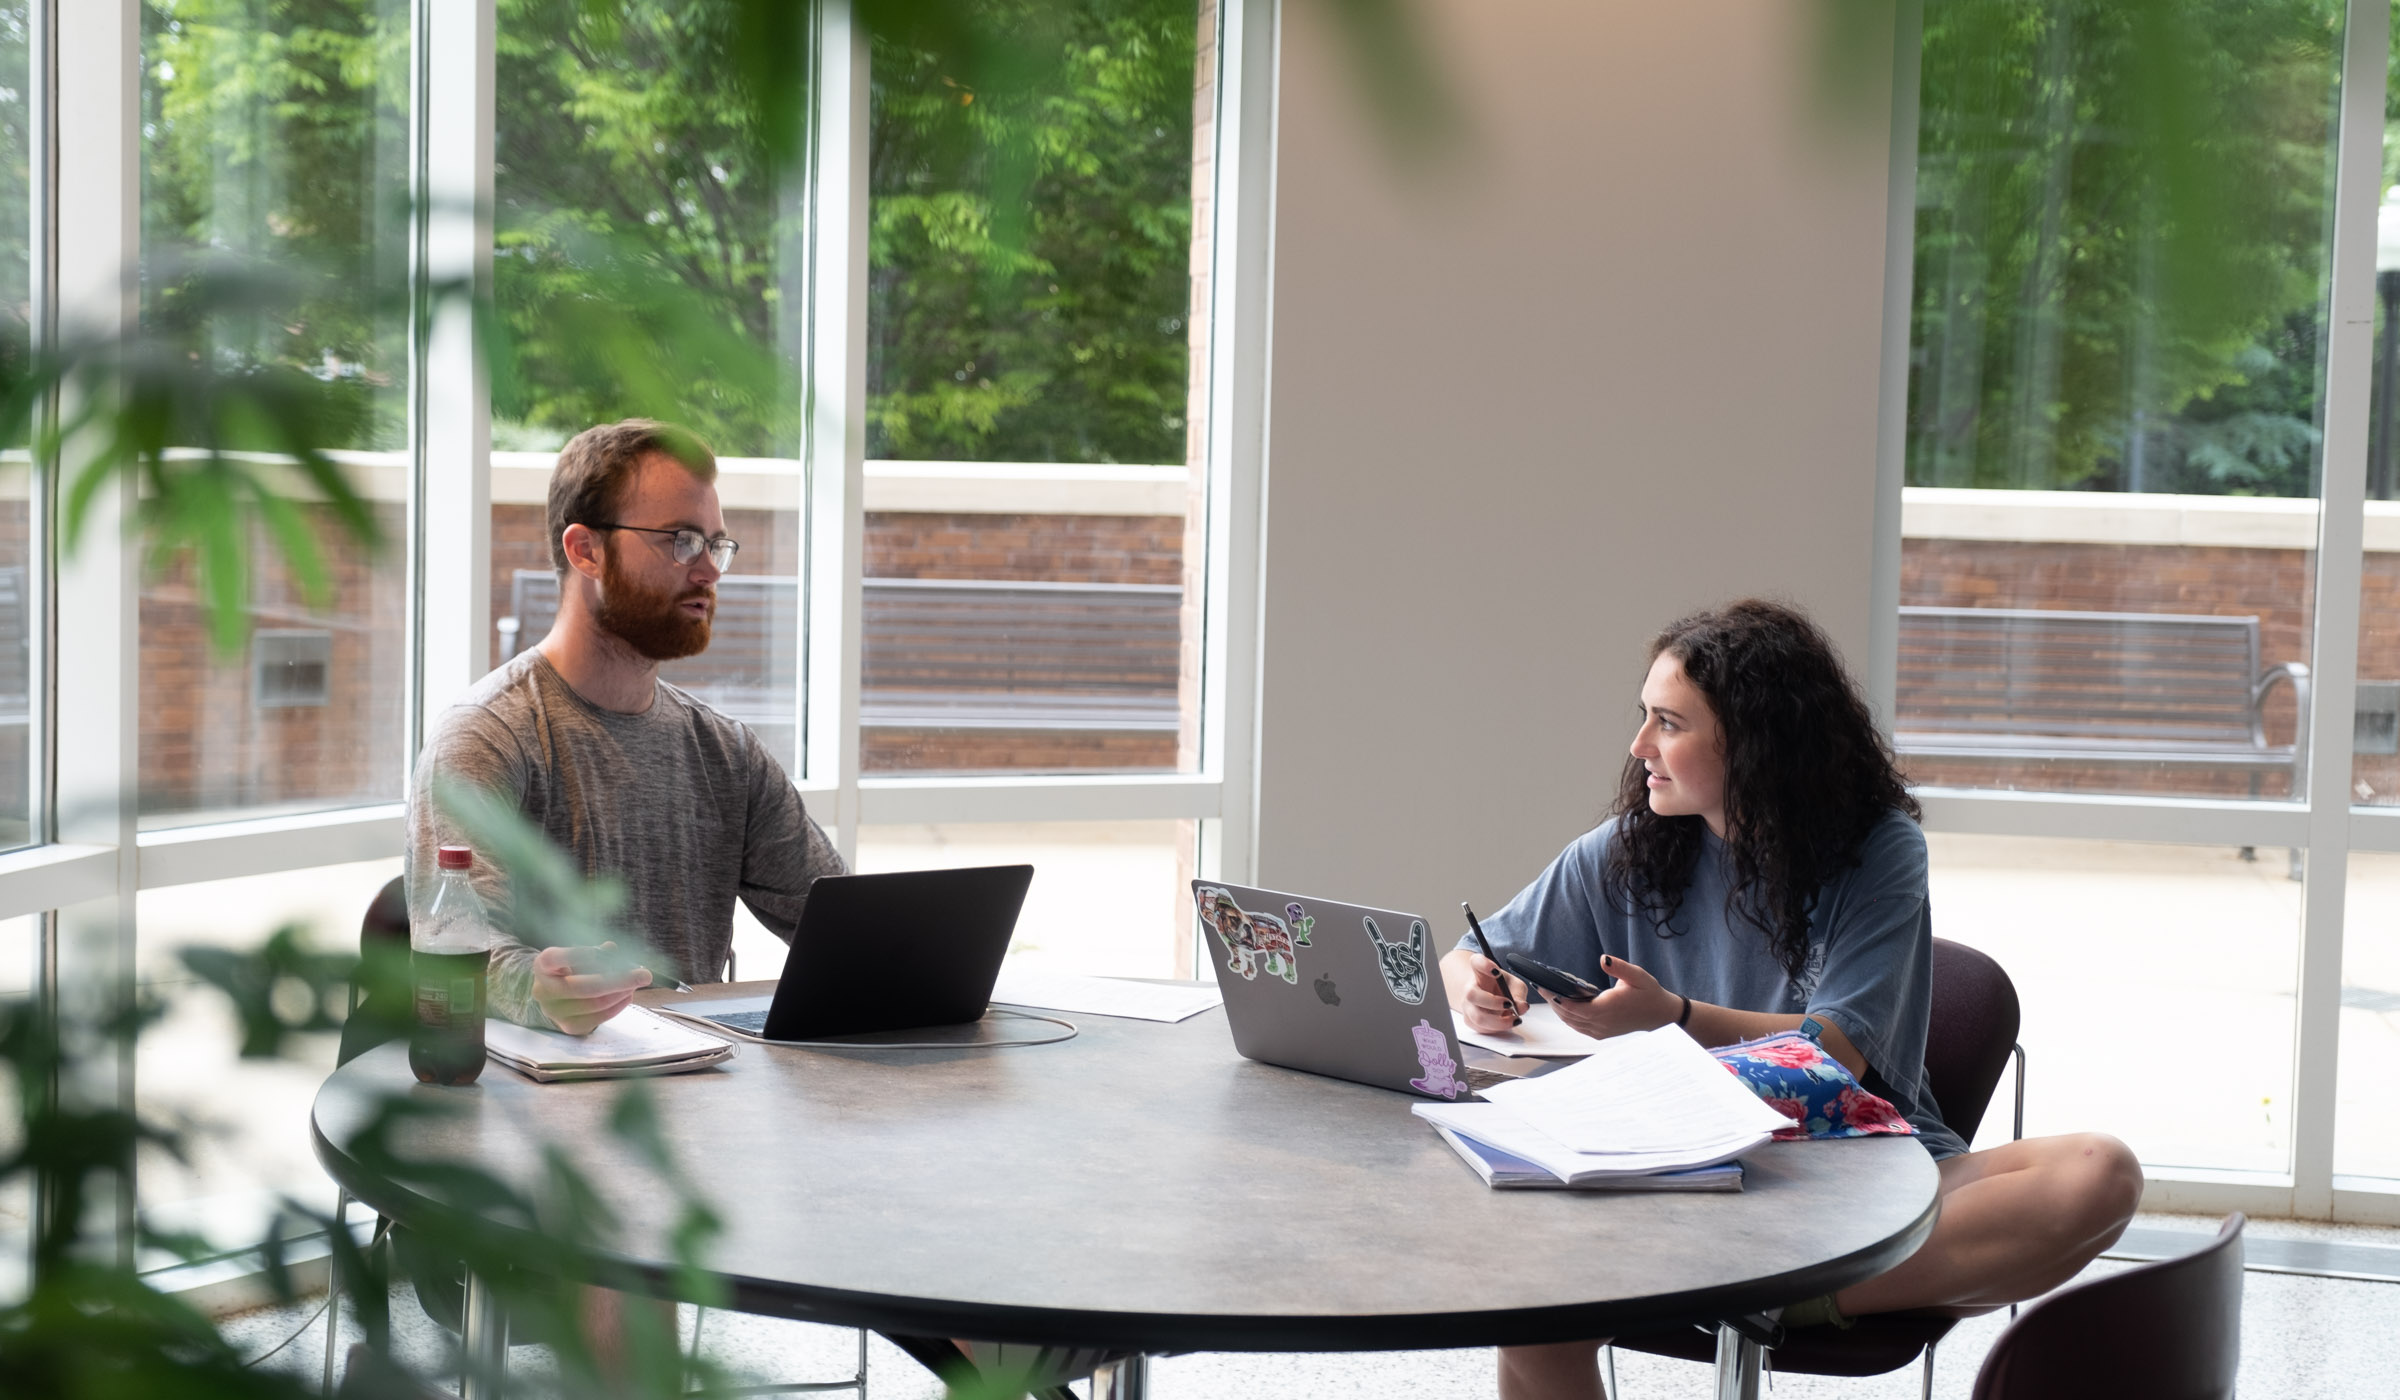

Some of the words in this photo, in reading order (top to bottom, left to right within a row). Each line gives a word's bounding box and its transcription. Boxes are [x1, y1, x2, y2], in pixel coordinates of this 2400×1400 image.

[435, 992, 448, 1001] 240
[1421, 1043, 1442, 1051] WOULD
[1419, 1050, 1456, 1073] Dolly
